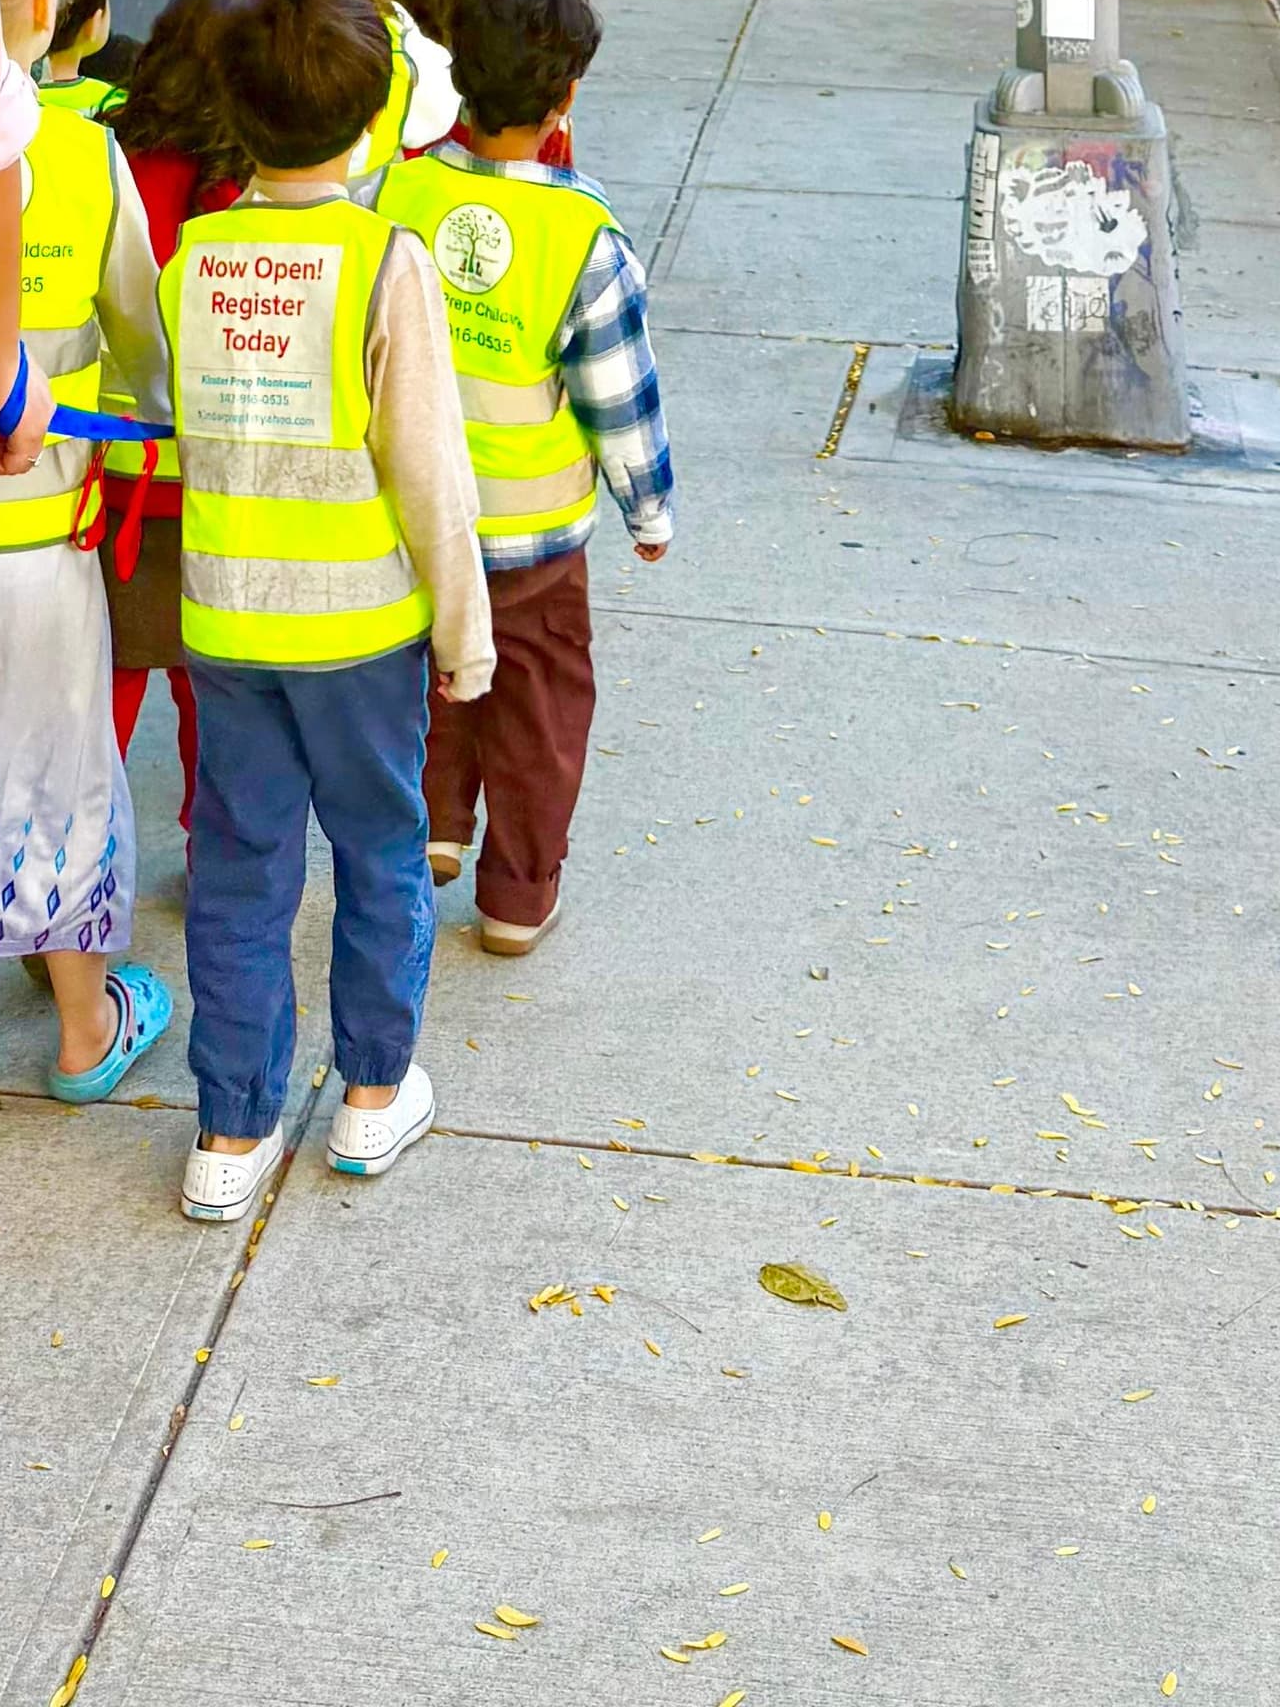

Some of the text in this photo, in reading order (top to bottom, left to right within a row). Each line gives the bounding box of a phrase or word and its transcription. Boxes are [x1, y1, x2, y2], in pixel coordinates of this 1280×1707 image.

[199, 255, 323, 286] Now Open!
[211, 291, 306, 320] Register
[222, 327, 291, 359] Today
[449, 322, 512, 354] 16-0535
[230, 376, 253, 388] Prep
